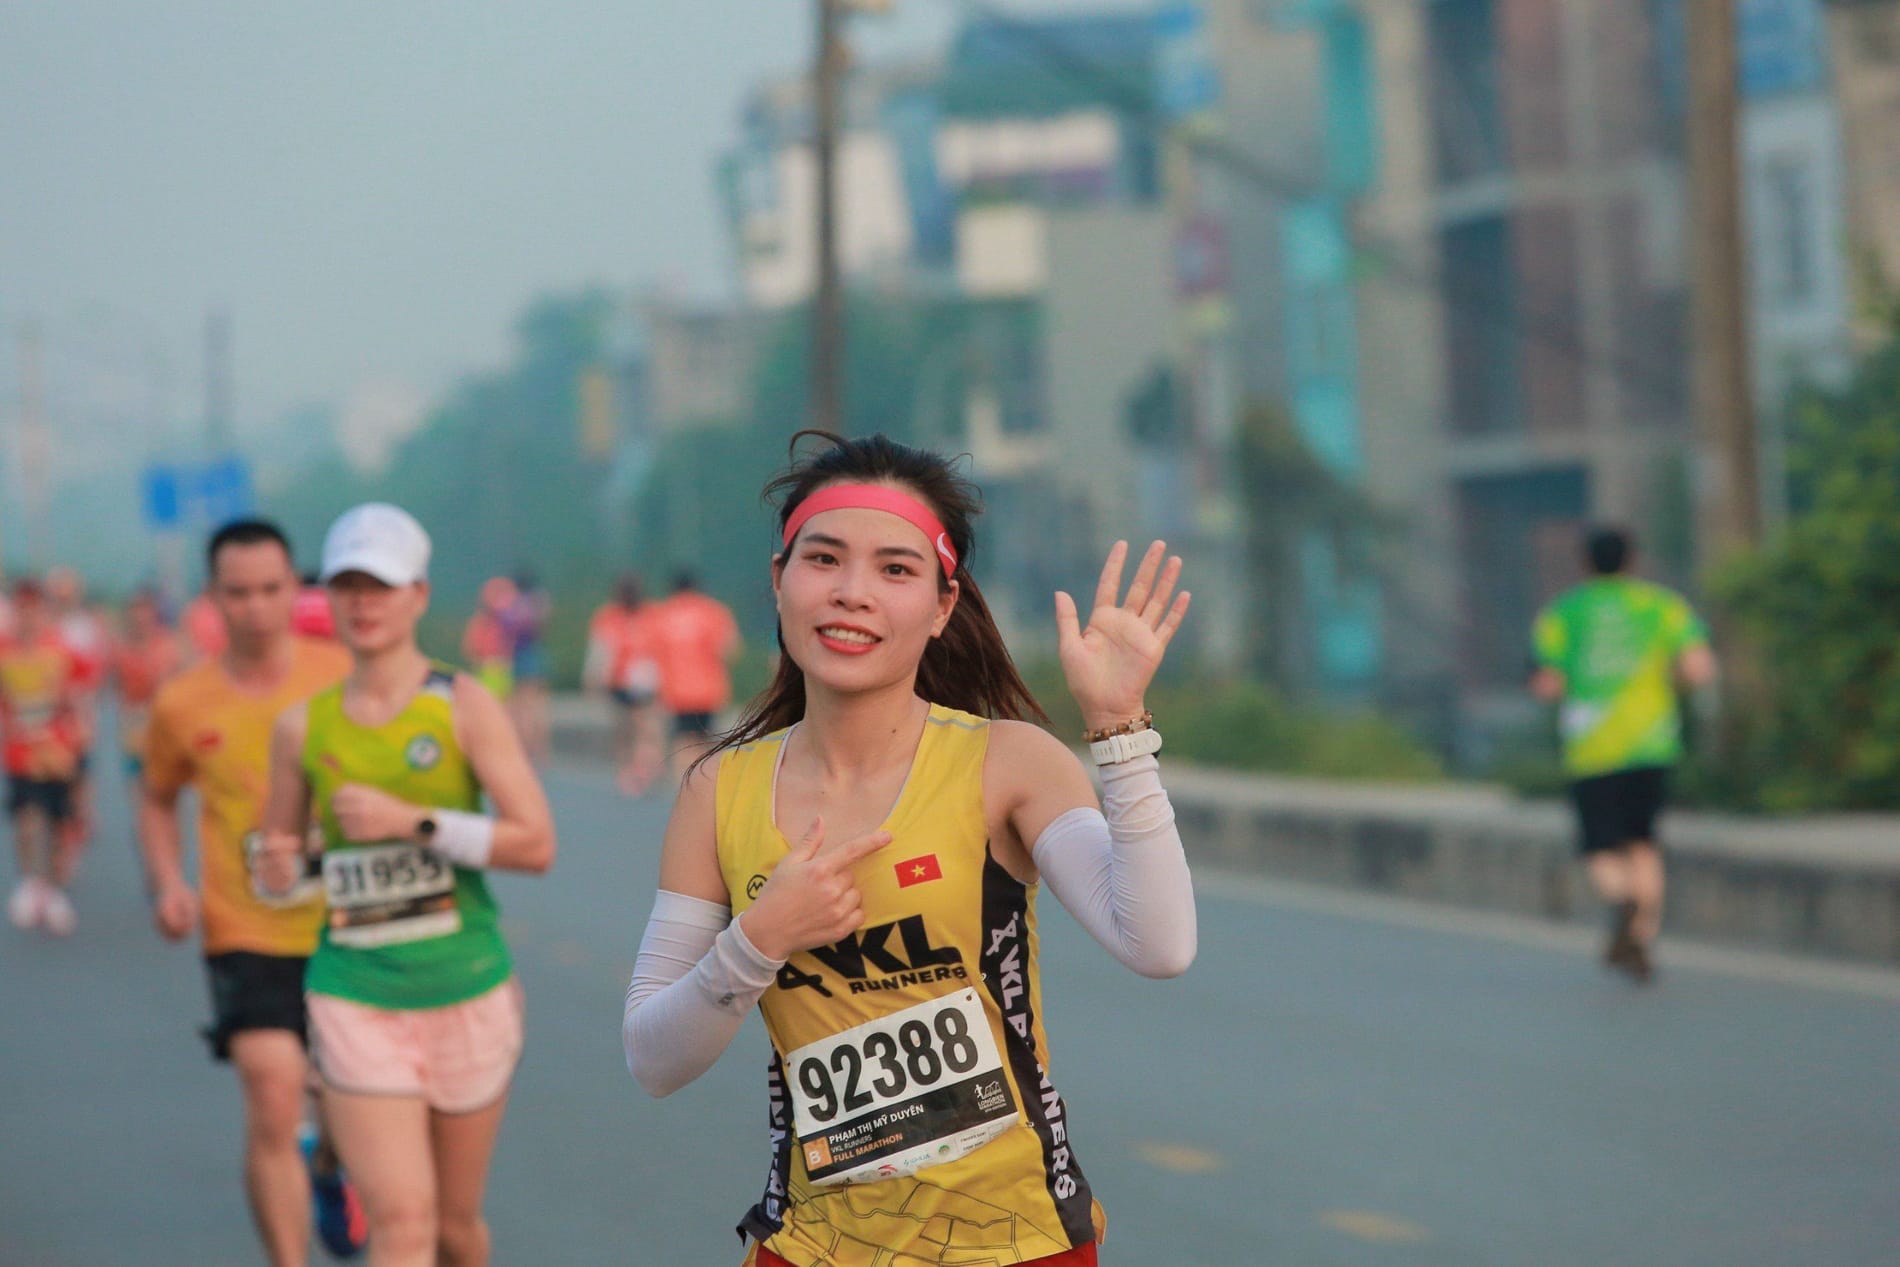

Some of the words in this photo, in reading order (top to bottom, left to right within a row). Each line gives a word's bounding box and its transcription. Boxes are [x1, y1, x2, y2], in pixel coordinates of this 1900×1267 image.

[849, 965, 968, 995] RUNNERS
[798, 1007, 979, 1123] 92388
[829, 1129, 857, 1145] PHẠM
[858, 1123, 873, 1137] THỊ
[874, 1114, 889, 1129] MỸ
[890, 1104, 925, 1122] DUYÊN
[808, 1150, 822, 1164] B
[833, 1150, 855, 1163] FULL
[856, 1133, 904, 1156] MARATHON
[844, 1135, 873, 1150] RUNNERS
